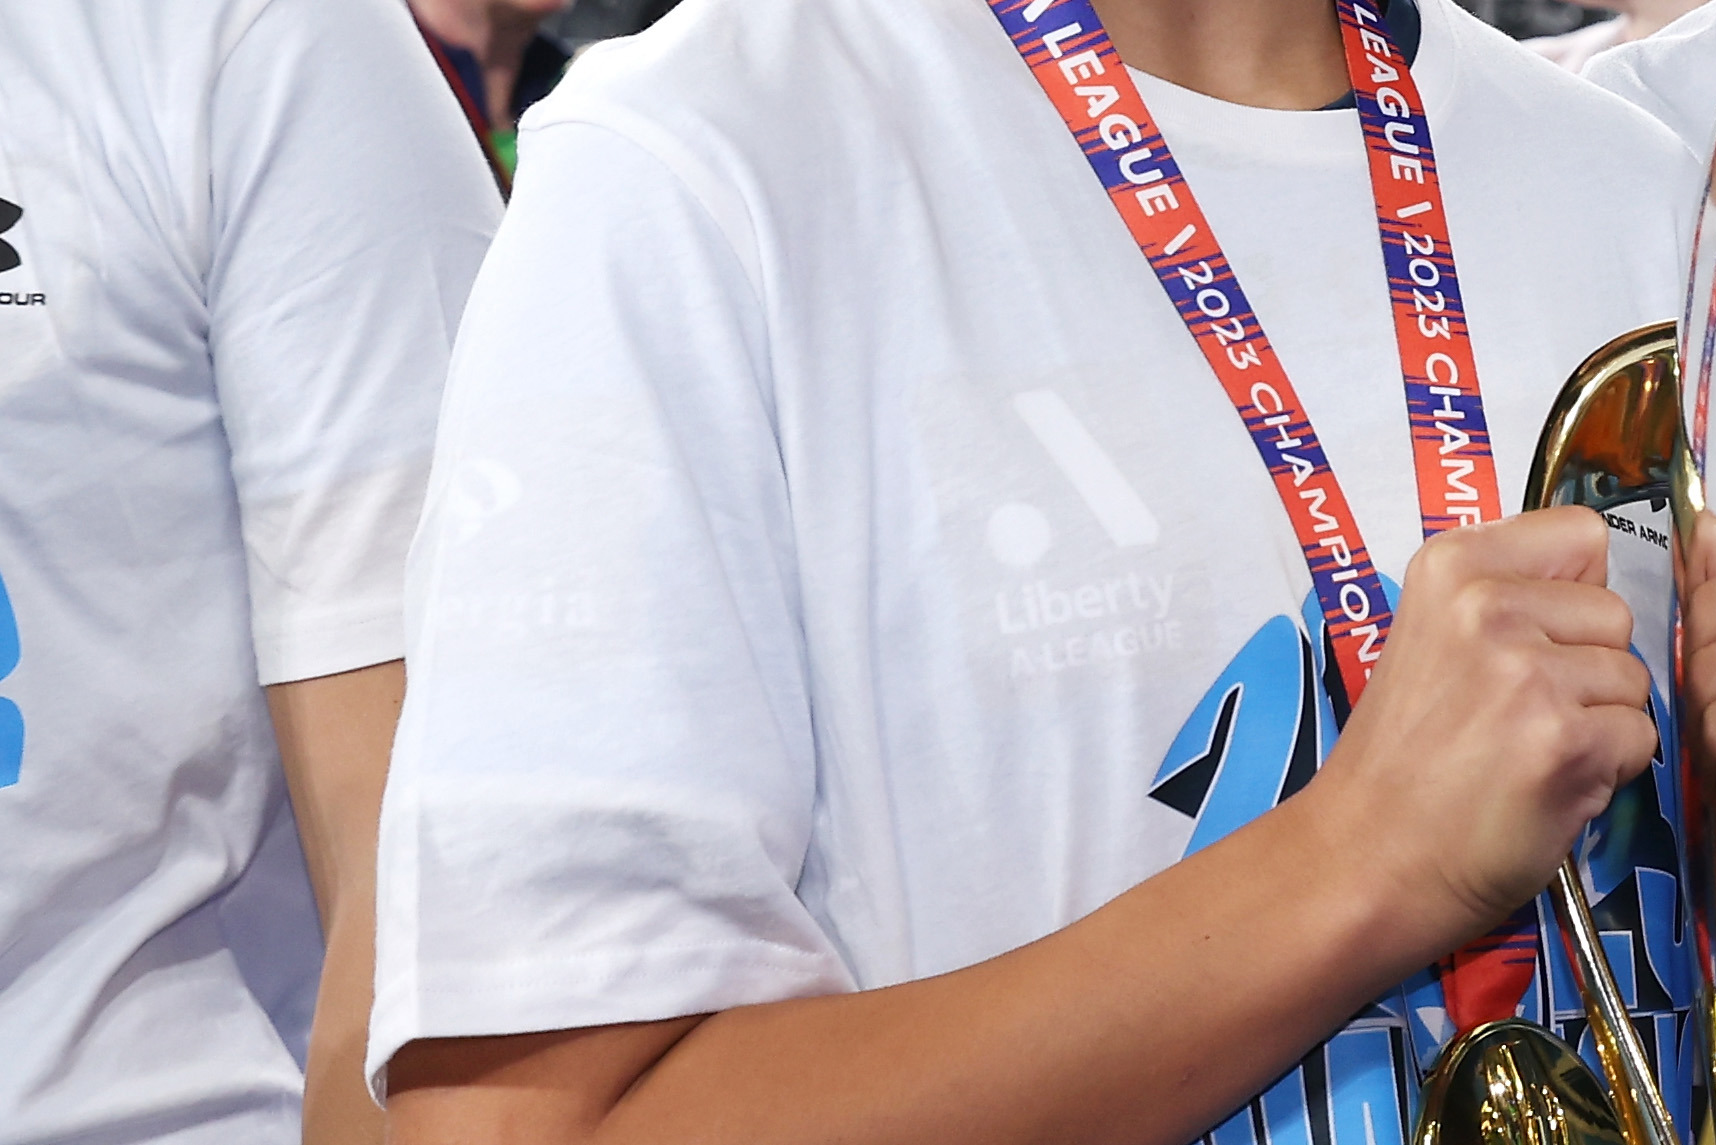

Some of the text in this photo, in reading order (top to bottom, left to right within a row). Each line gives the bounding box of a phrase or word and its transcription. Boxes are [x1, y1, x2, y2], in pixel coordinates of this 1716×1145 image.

[1353, 2, 1425, 185] LEAGUE
[1402, 231, 1451, 340] 2023
[1042, 22, 1180, 217] LEAGUE
[1178, 261, 1262, 370] 2023
[1249, 381, 1381, 680] CHAMPION
[995, 571, 1174, 635] Liberty
